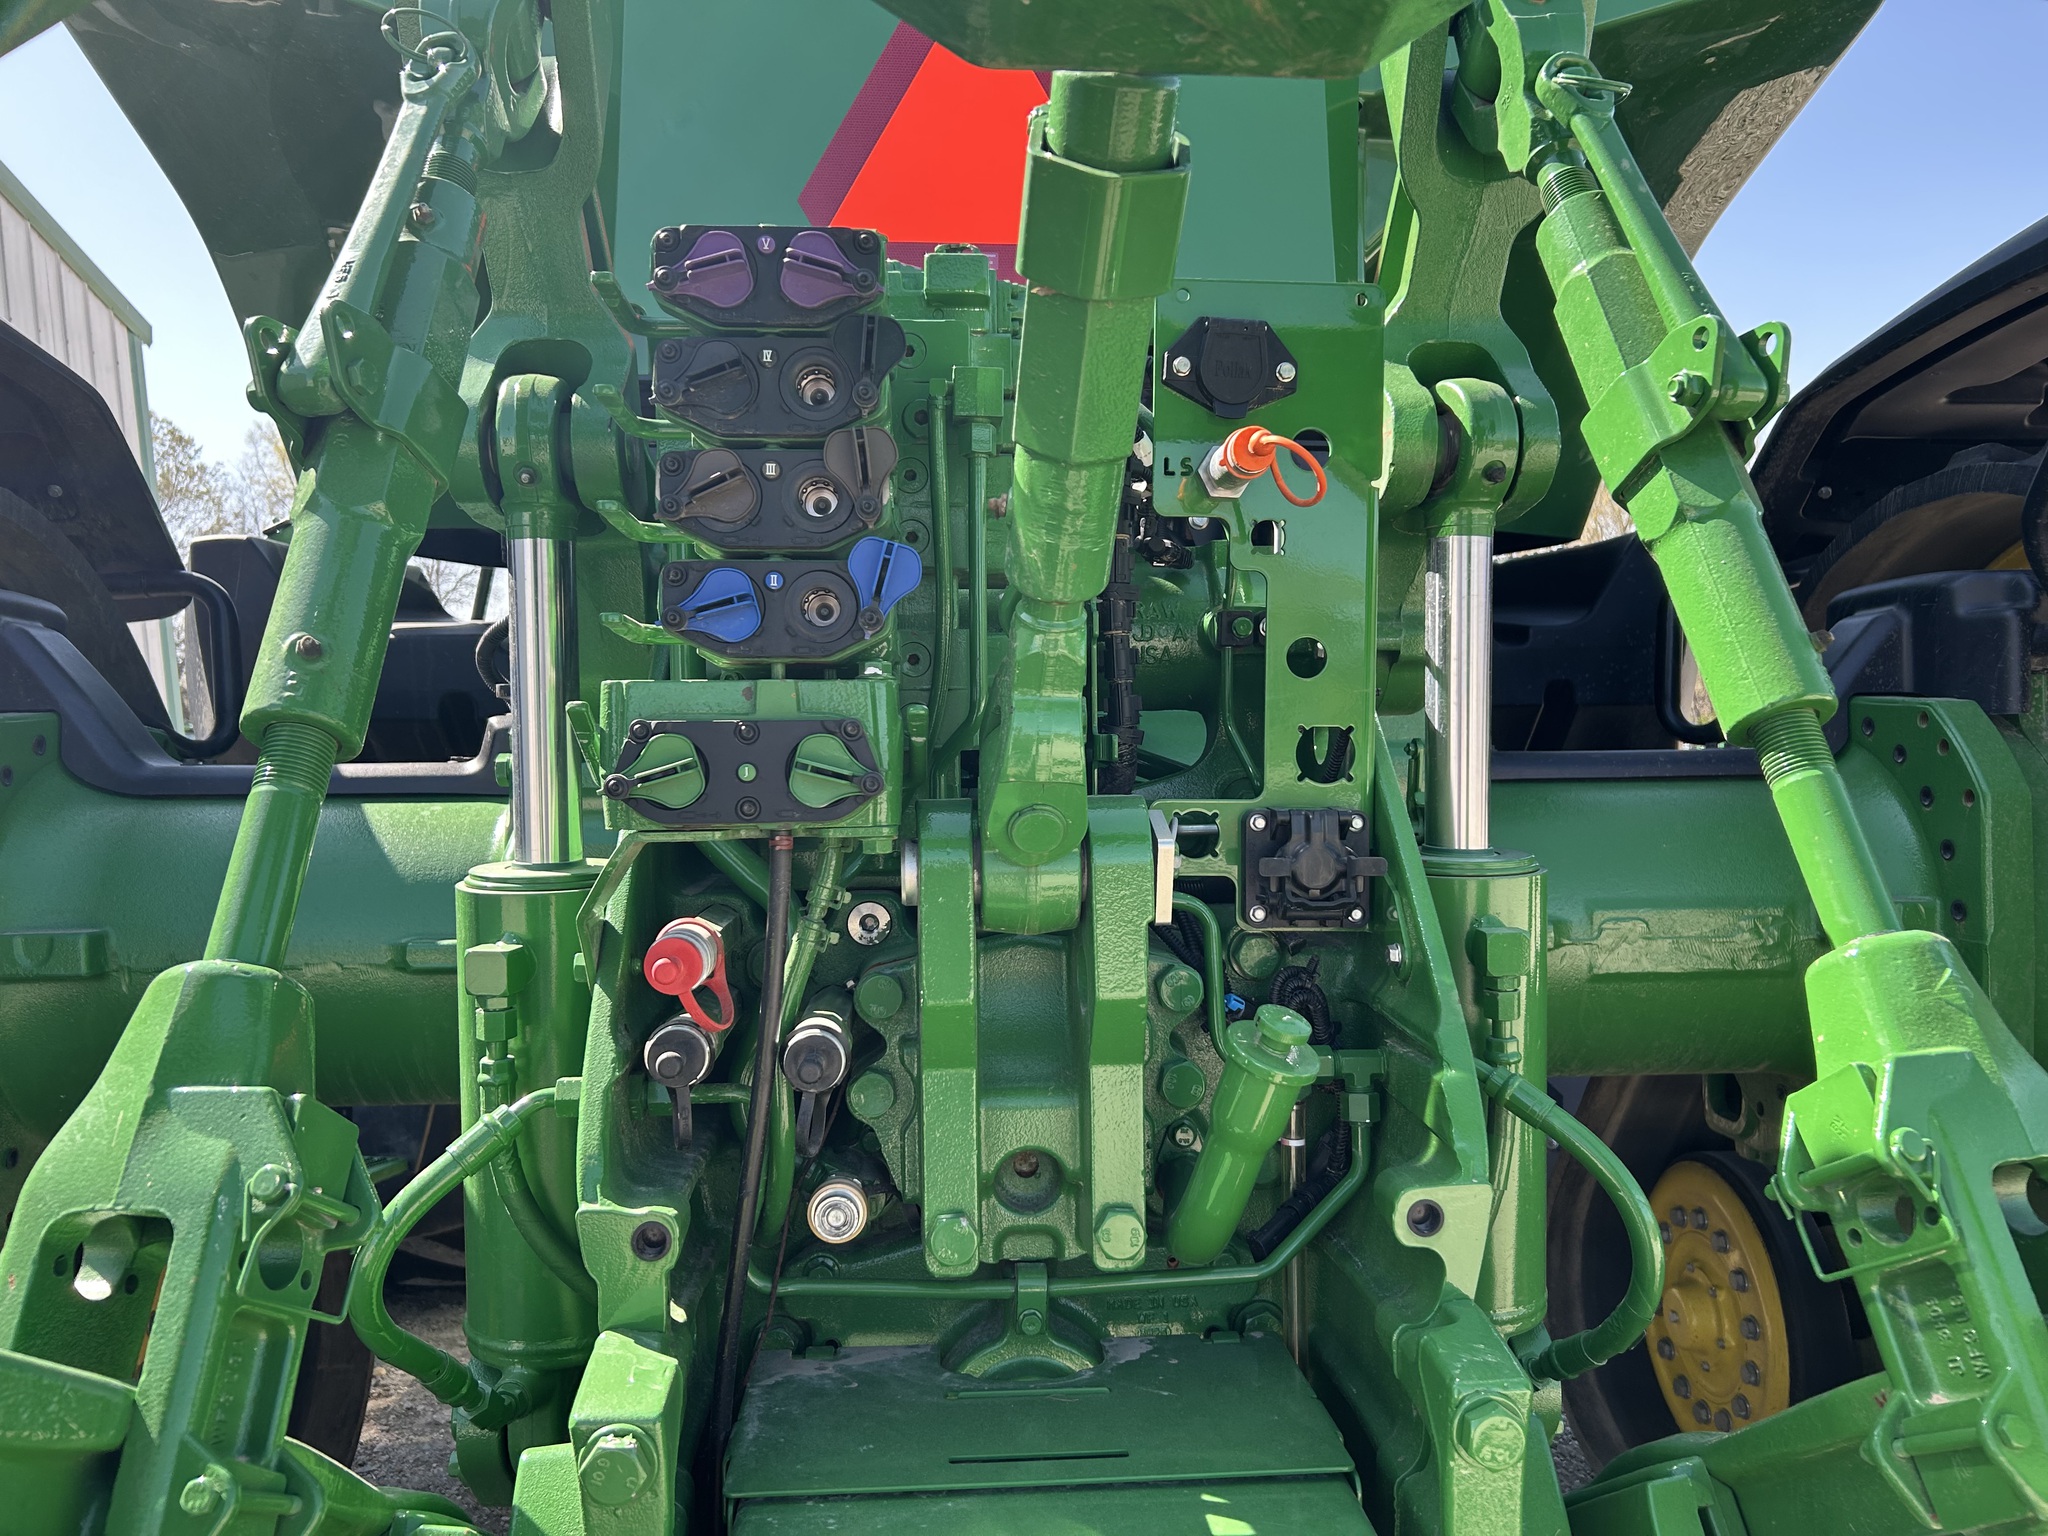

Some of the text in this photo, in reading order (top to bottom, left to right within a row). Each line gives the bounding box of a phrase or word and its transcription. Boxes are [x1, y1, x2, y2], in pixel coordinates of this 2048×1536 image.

[762, 237, 771, 250] V
[763, 349, 773, 362] IV
[1214, 360, 1252, 379] Pollak
[765, 463, 777, 475] III
[770, 574, 778, 587] II
